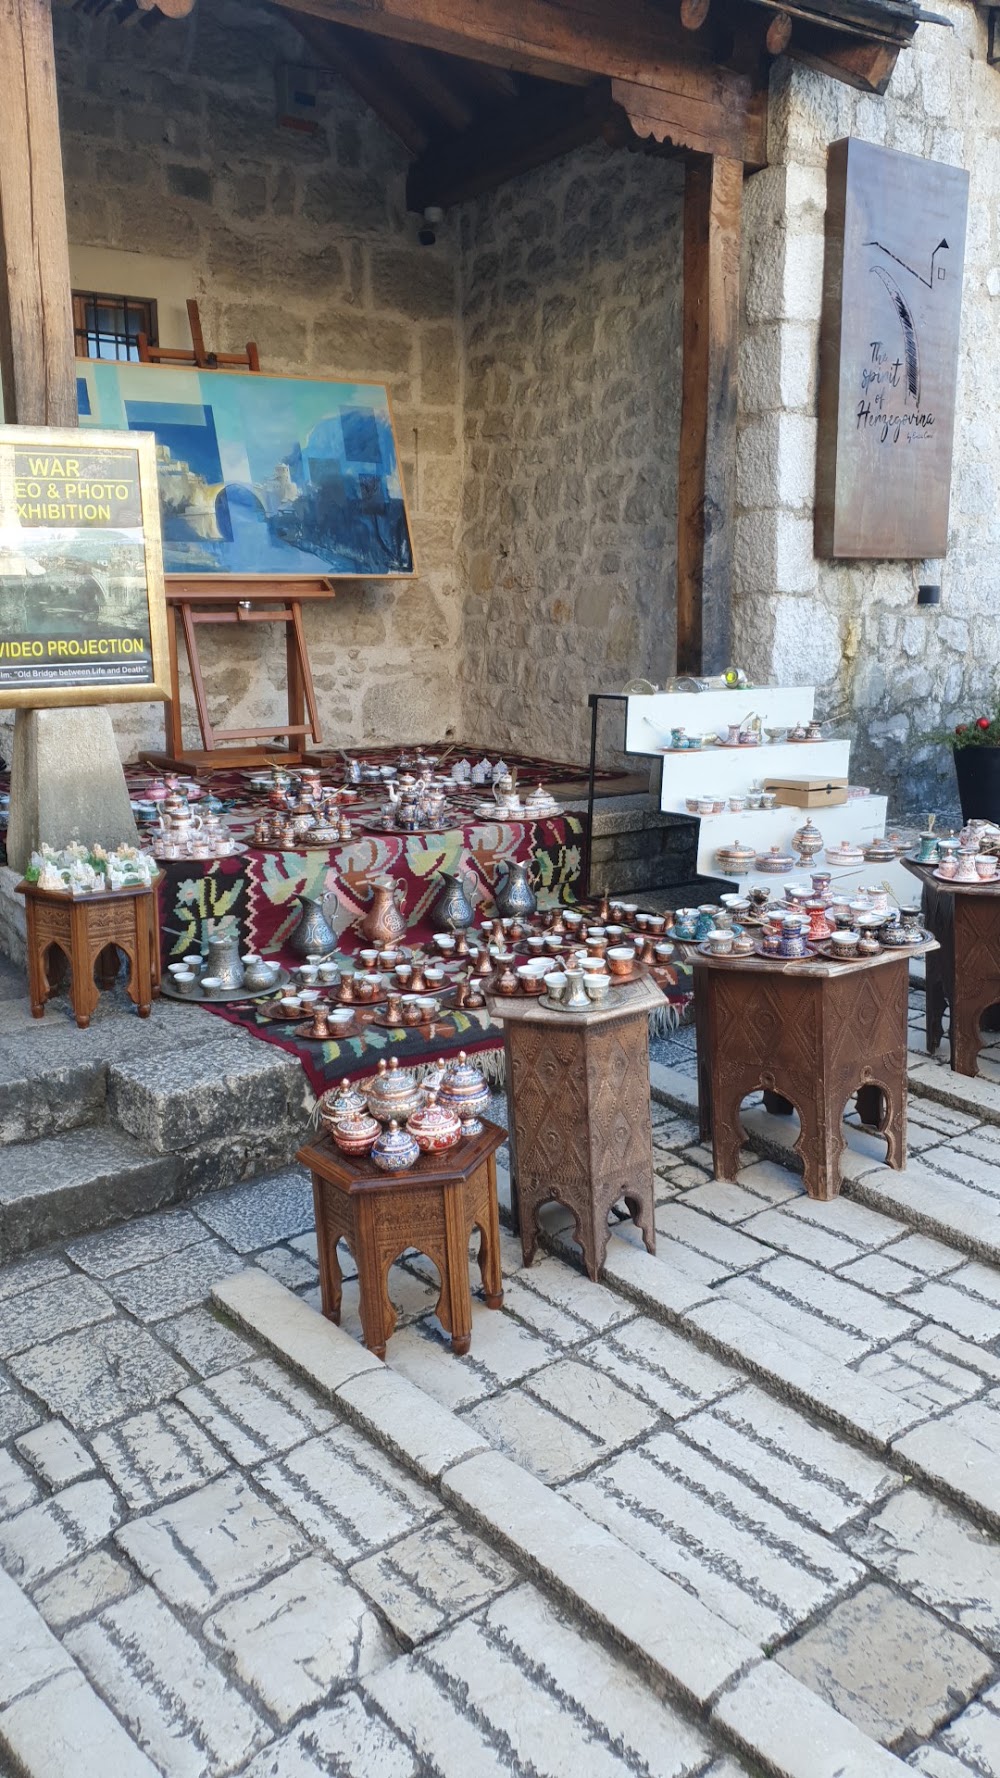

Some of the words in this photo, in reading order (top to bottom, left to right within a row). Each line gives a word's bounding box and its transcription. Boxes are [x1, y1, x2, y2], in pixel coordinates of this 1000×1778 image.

[870, 341, 888, 365] The
[861, 358, 903, 395] spirit
[874, 387, 885, 410] of
[856, 399, 936, 443] Herzegovina
[28, 457, 81, 477] WAR
[47, 482, 60, 499] &
[65, 483, 129, 500] PHOTO
[16, 503, 111, 520] XHIBITION
[47, 637, 144, 656] PROJECTION
[32, 669, 58, 678] Bridge
[58, 667, 91, 677] between
[91, 667, 106, 675] Life
[106, 667, 121, 675] and
